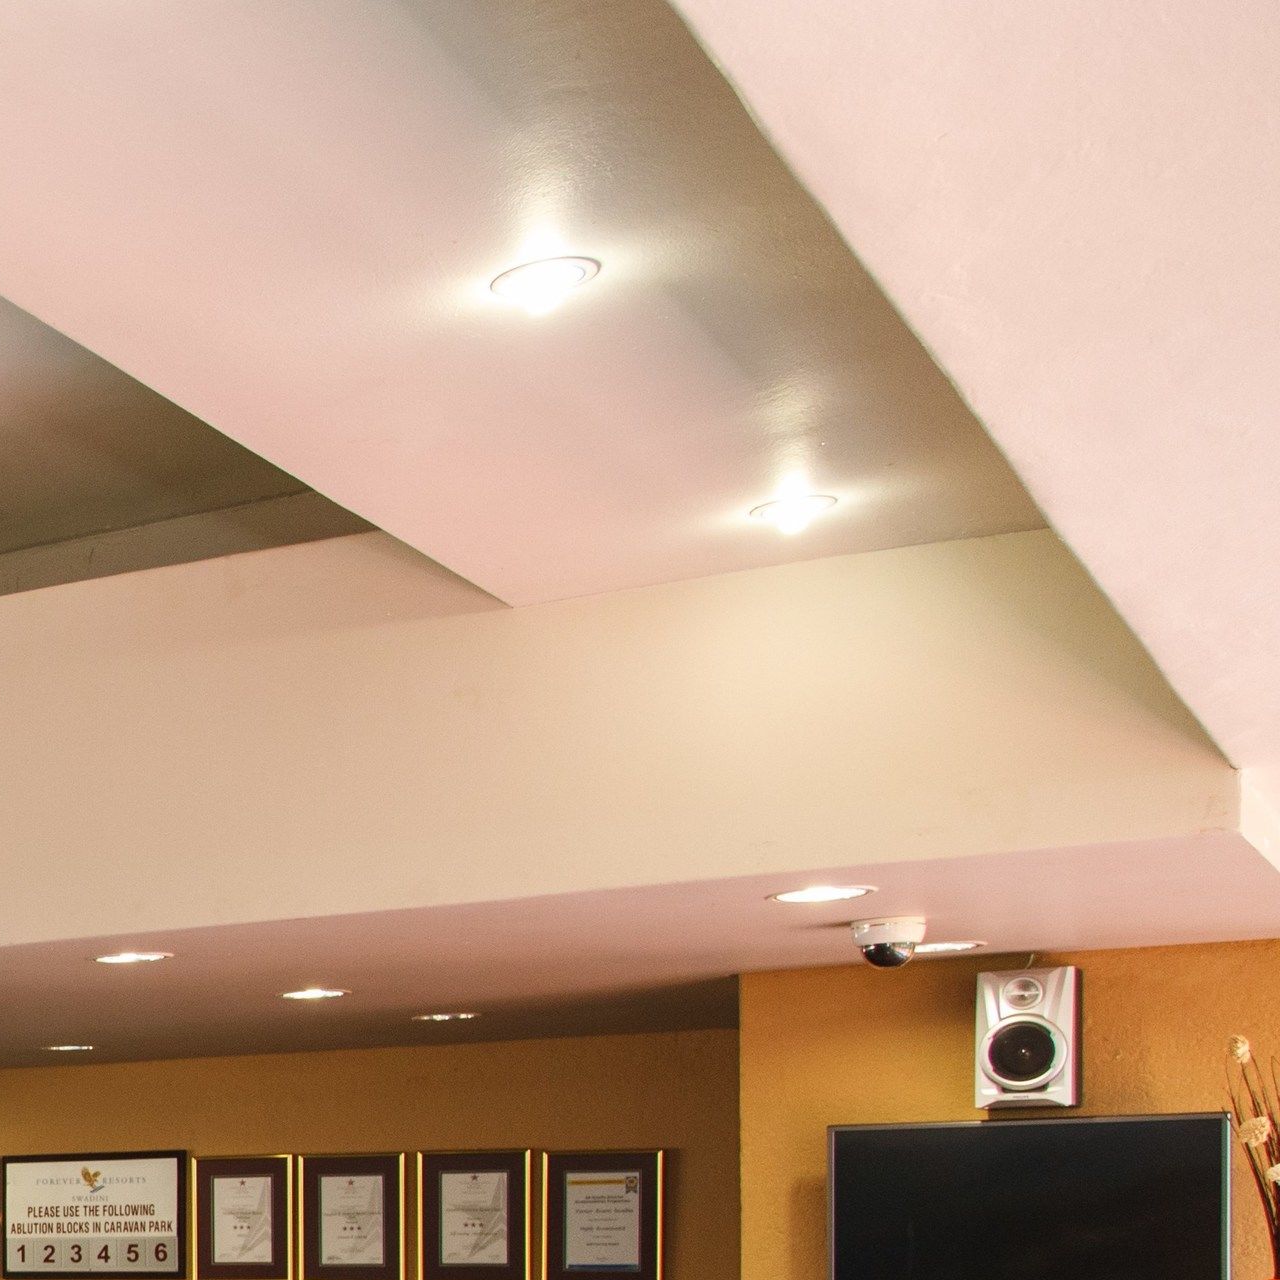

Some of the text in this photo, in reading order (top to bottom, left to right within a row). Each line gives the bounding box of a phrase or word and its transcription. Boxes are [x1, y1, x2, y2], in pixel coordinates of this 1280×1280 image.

[36, 1176, 146, 1185] FOREVER RESORTS
[27, 1204, 156, 1218] PLEASE USE THE FOLLOWING
[11, 1220, 173, 1235] ABLUTION BLOCKS IN CARAVAN PARK
[17, 1243, 168, 1263] 1 2 3 4 5 6
